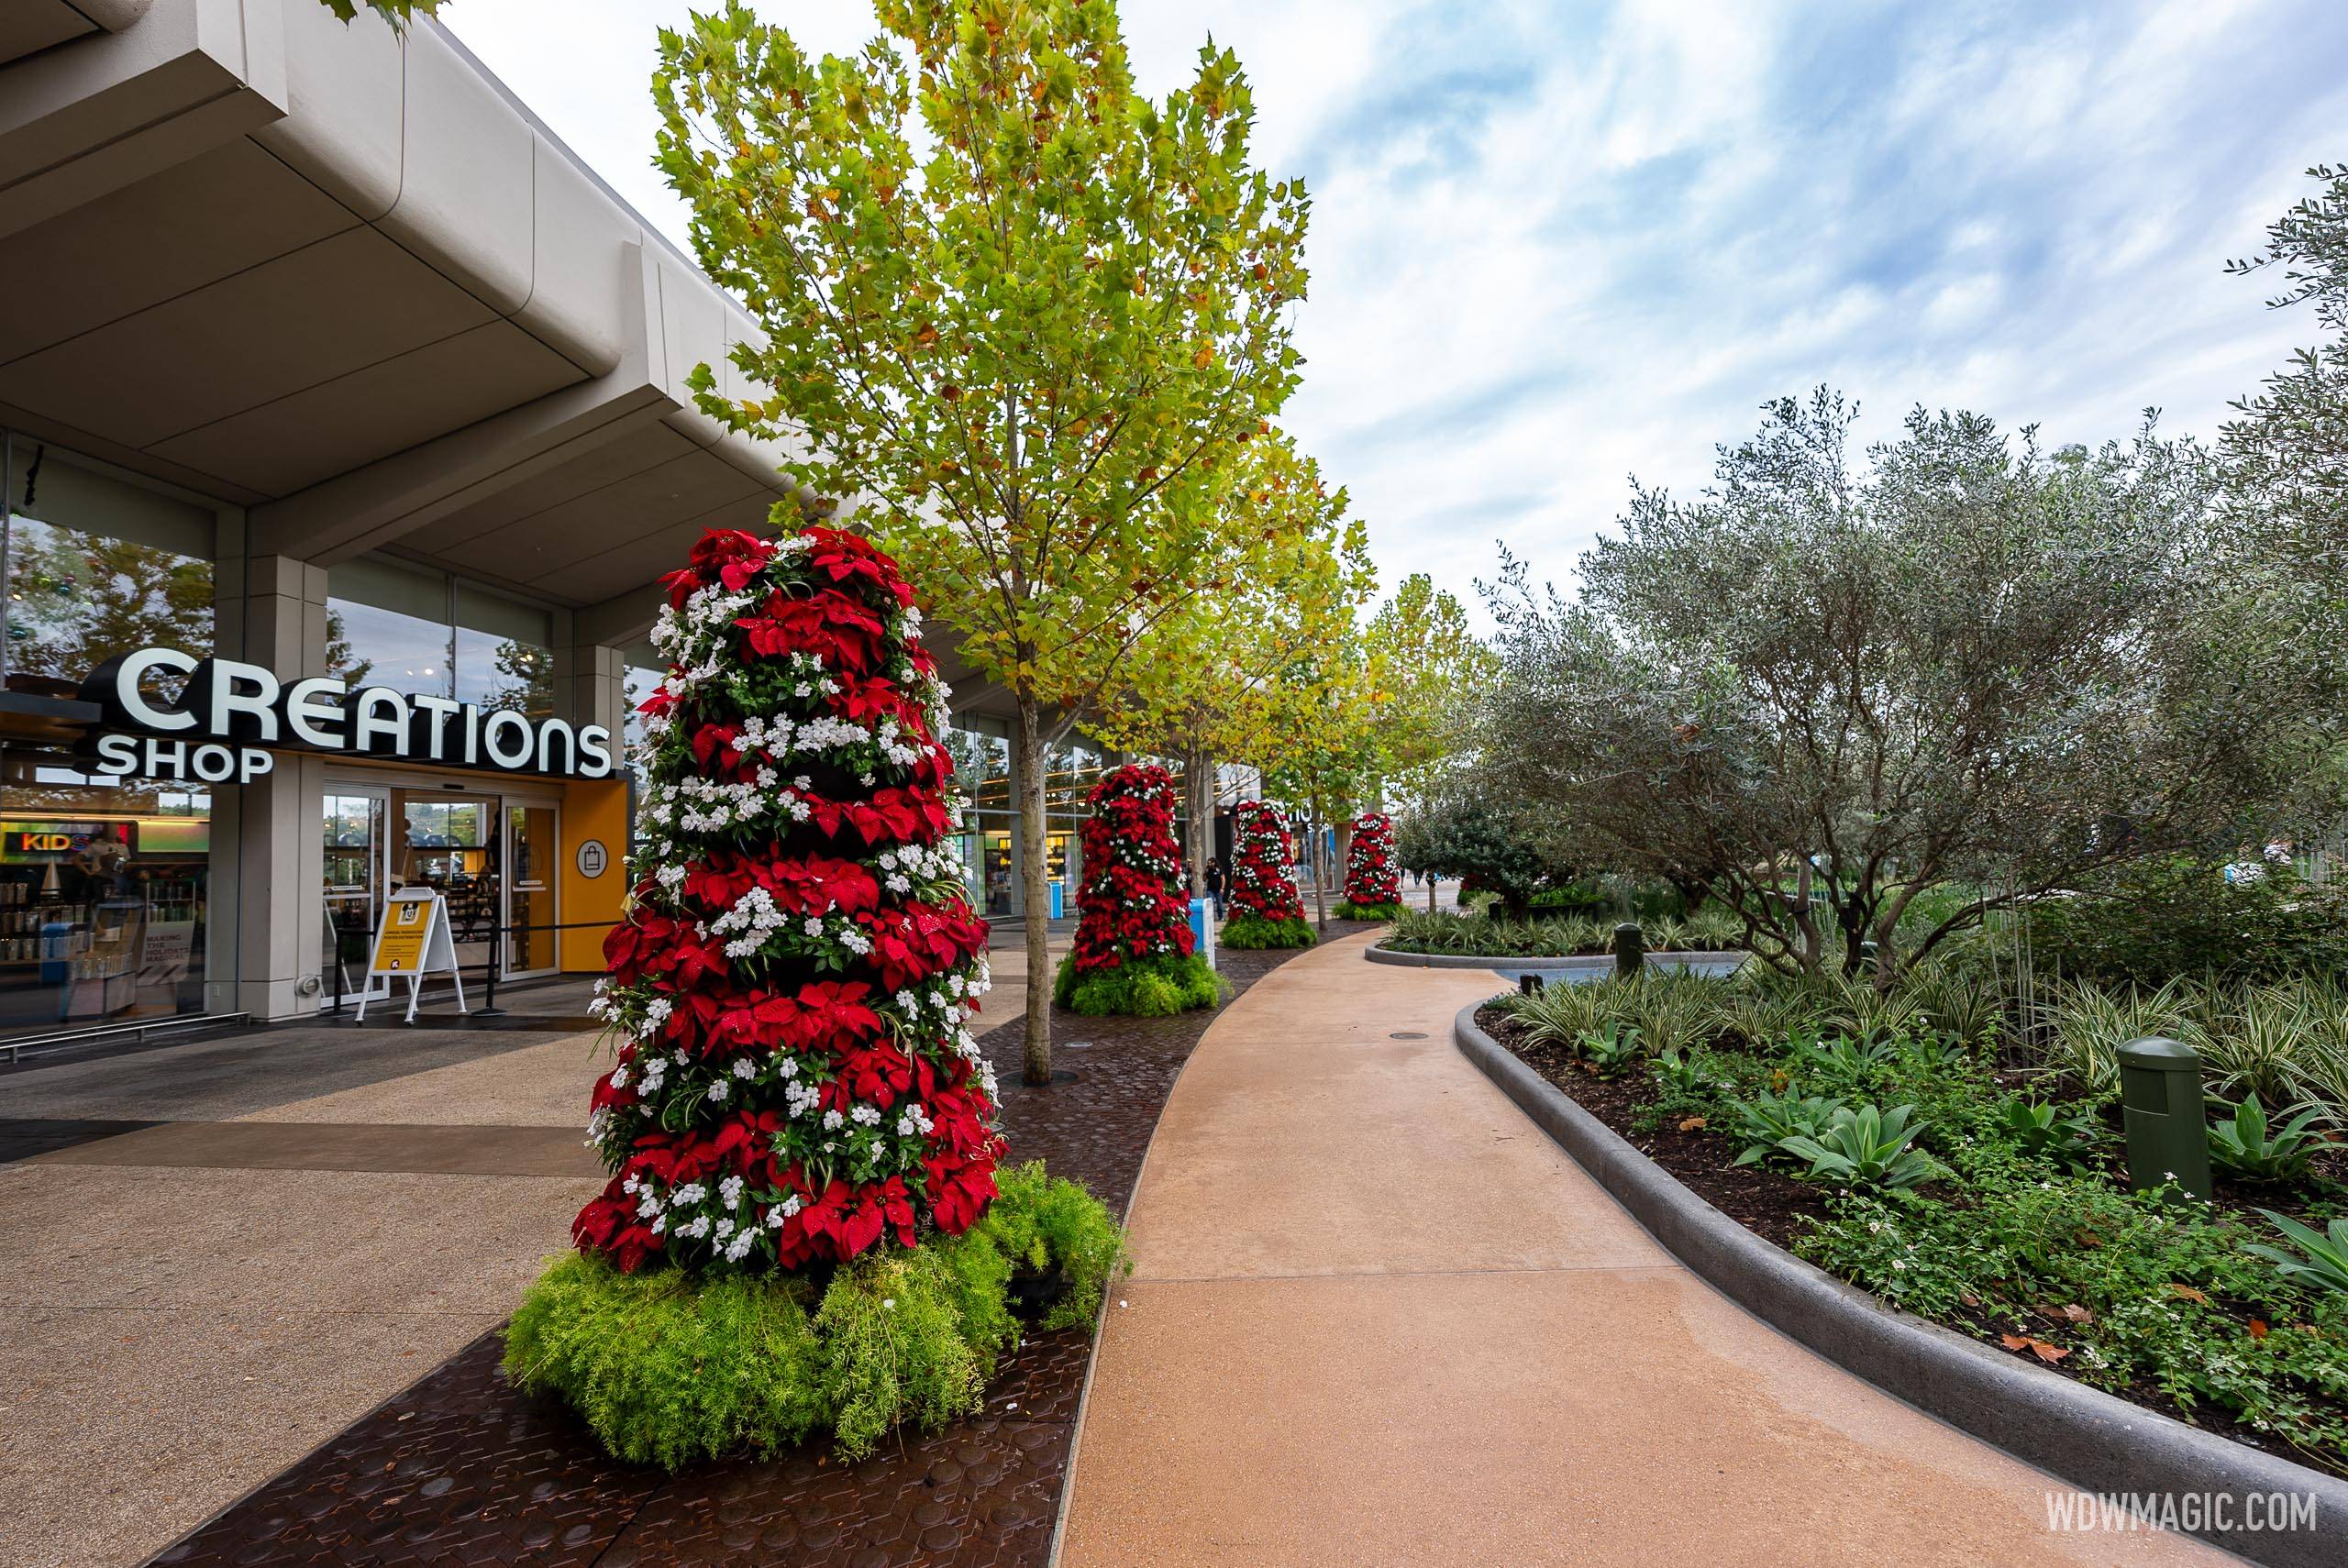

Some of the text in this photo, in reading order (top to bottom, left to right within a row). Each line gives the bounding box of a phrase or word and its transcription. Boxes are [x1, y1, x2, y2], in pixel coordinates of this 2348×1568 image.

[116, 647, 612, 778] CREATIONS
[96, 734, 274, 784] SHOP
[21, 833, 91, 852] KIDS
